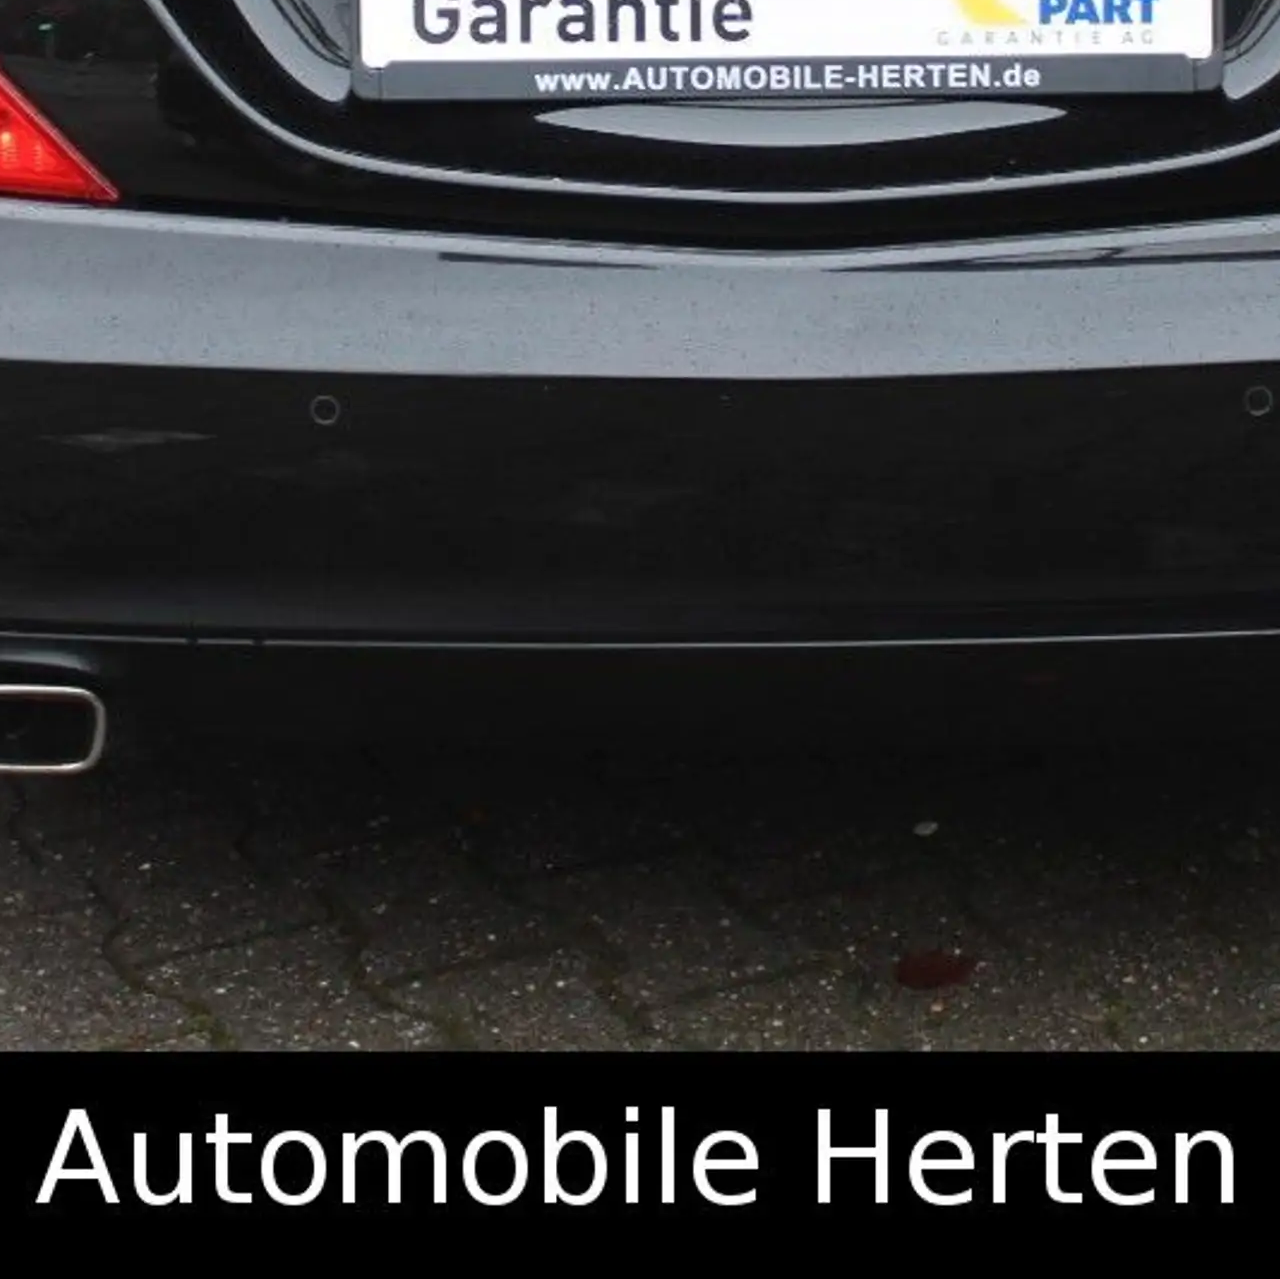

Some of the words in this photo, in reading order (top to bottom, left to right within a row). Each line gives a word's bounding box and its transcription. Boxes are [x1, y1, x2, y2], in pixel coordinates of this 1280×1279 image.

[936, 30, 1102, 46] GARANTIE
[1120, 29, 1155, 45] AG
[534, 63, 1042, 92] www.AUTOMOBILE-HERTEN.de
